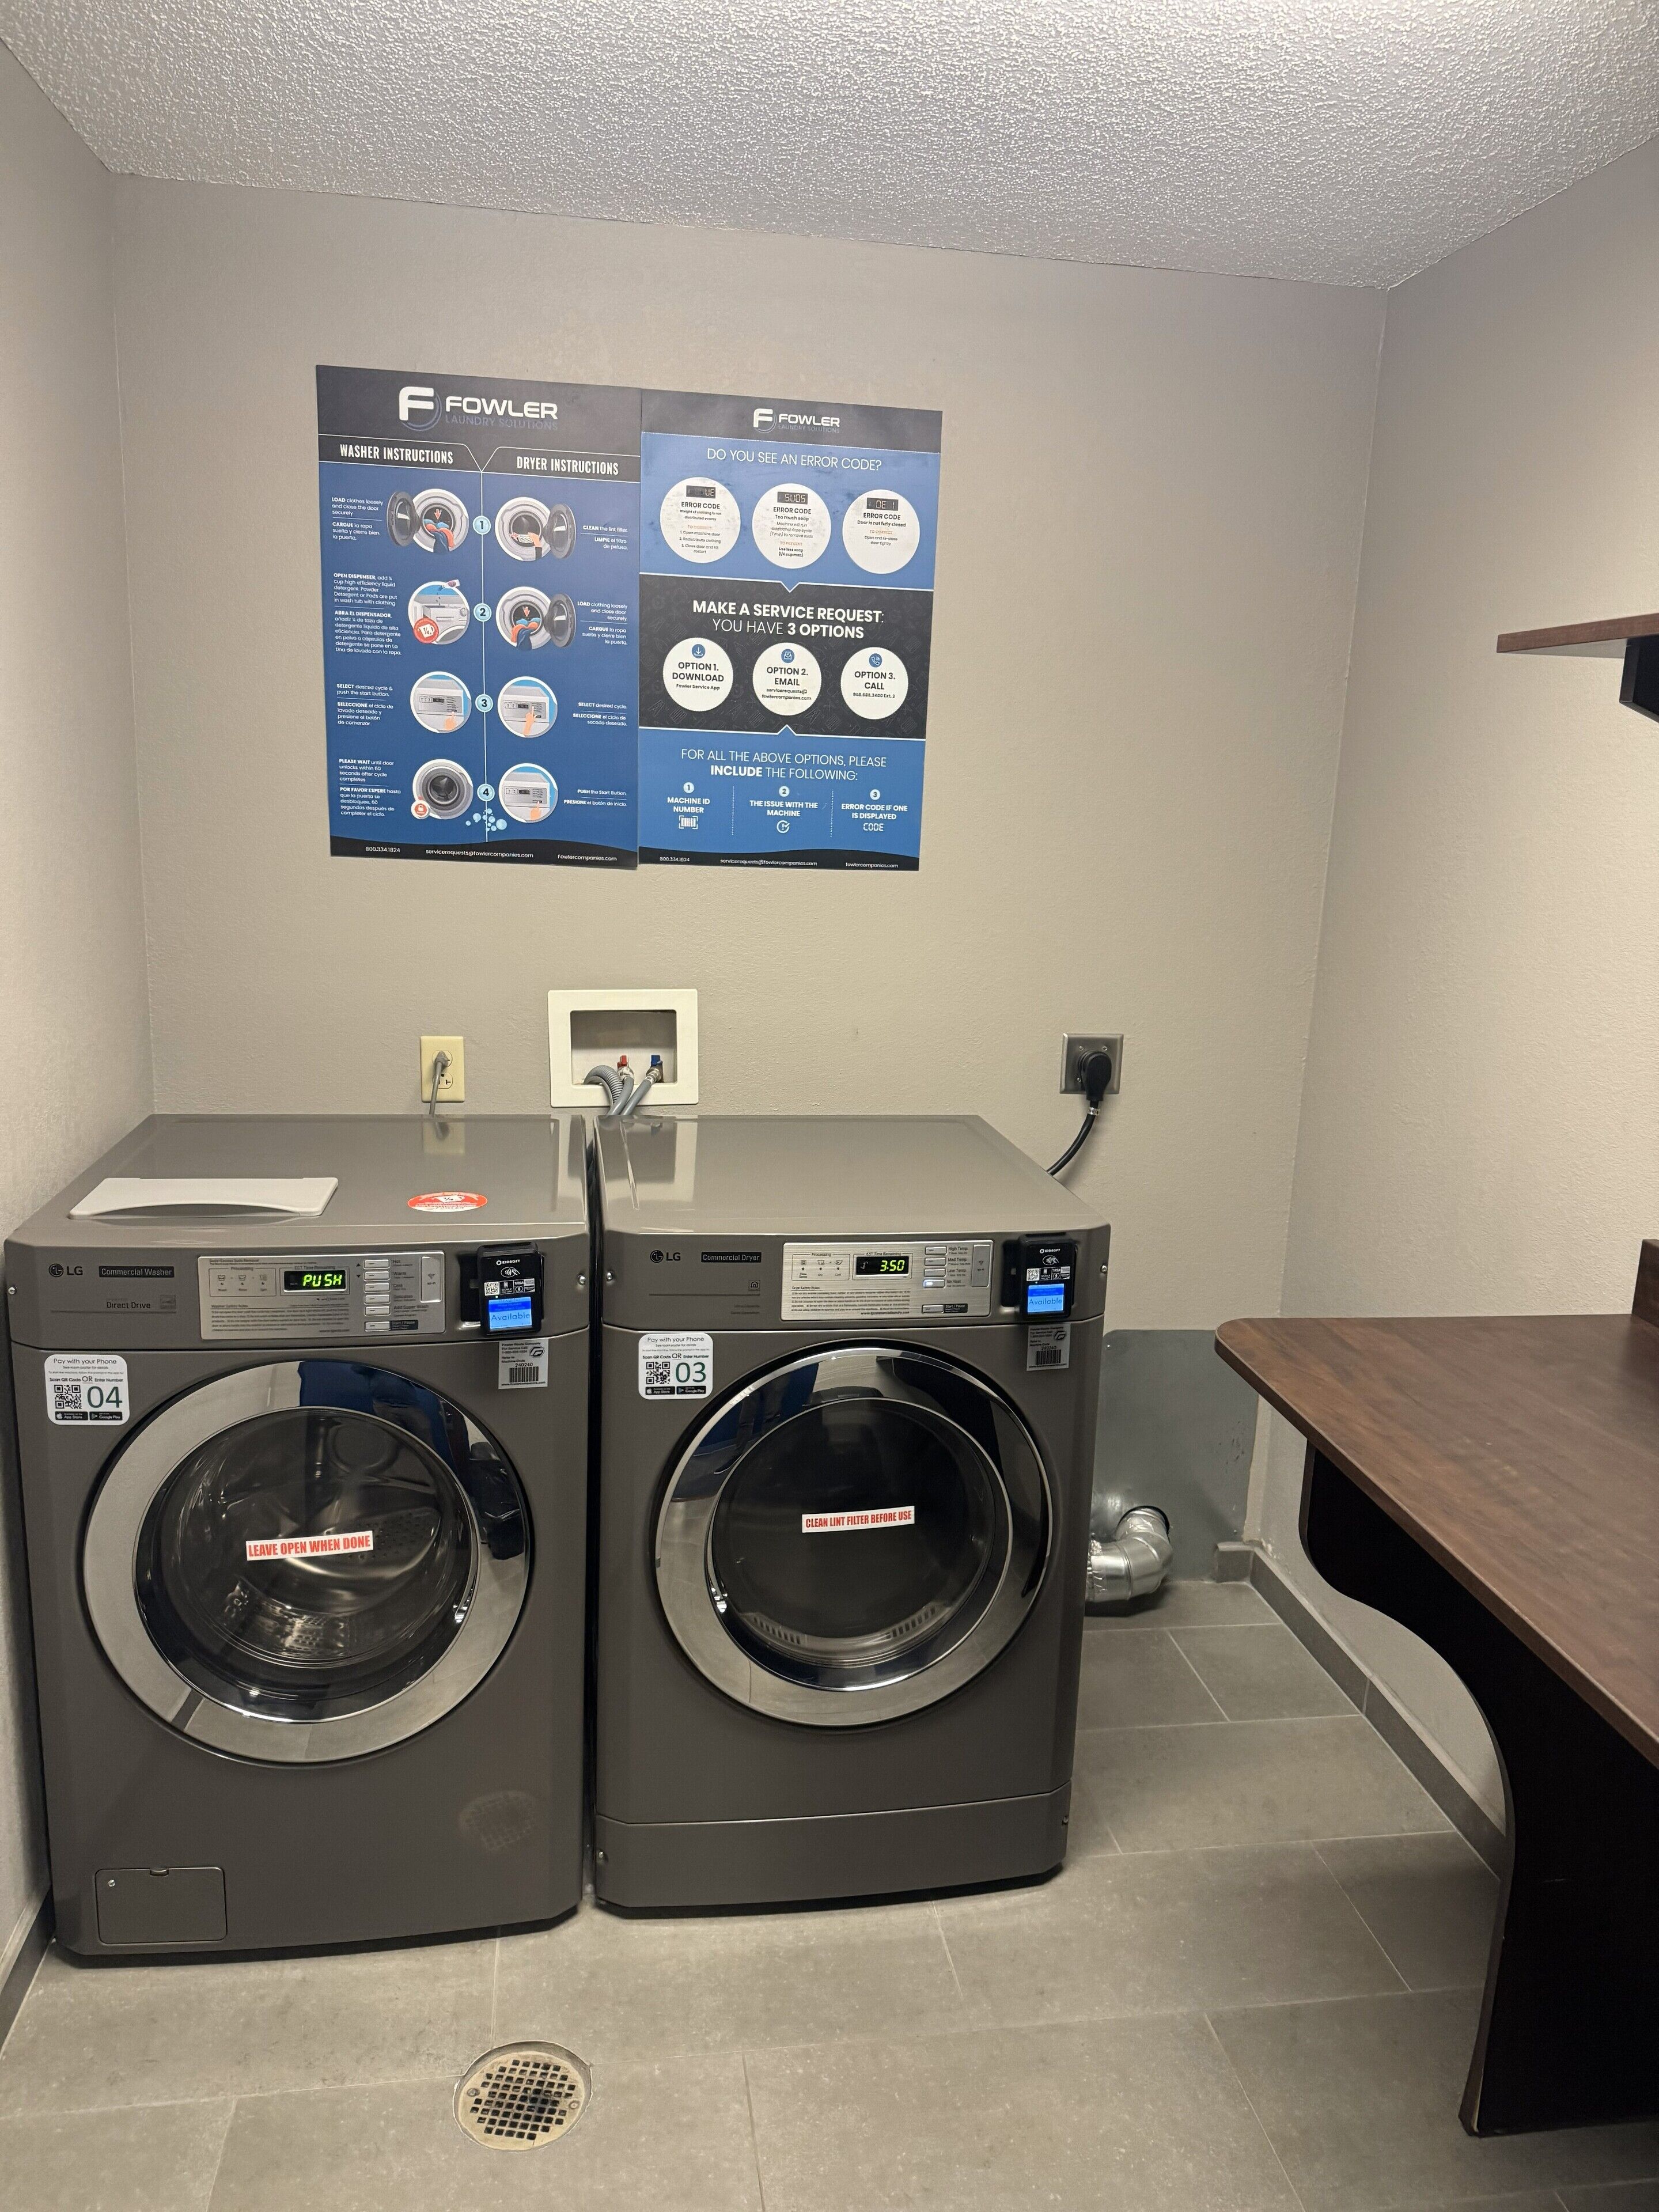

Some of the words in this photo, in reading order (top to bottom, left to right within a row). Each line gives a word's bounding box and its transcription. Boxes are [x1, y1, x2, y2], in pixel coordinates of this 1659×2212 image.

[446, 396, 558, 419] FOWLER
[446, 414, 495, 426] LAUNDRY
[499, 418, 558, 430] SOLUTIONS
[779, 414, 840, 427] FOWLER
[340, 444, 379, 459] WASHER
[384, 448, 453, 463] INSTRUCTIONS
[707, 448, 726, 460] DO
[730, 450, 754, 461] YOU
[758, 452, 778, 463] SEE
[781, 454, 797, 465] AN
[801, 455, 838, 468] ERROR
[842, 458, 881, 471] CODE?
[517, 457, 547, 471] DRYER
[551, 459, 619, 475] INSTRUCTIONS
[693, 600, 736, 615] MAKE
[739, 603, 750, 615] A
[754, 604, 814, 619] SERVICE
[817, 608, 884, 623] REQUEST:
[713, 619, 742, 632] YOU
[747, 620, 783, 634] HAVE
[787, 623, 796, 635] 3
[800, 624, 863, 638] OPTIONS
[678, 662, 711, 671] OPTION
[767, 666, 799, 675] OPTION
[672, 673, 724, 682] DOWNLOAD
[855, 671, 886, 679] OPTION
[681, 749, 704, 760] FOR
[707, 750, 726, 760] ALL
[729, 751, 749, 762] THE
[753, 752, 791, 763] ABOVE
[795, 754, 846, 767] OPTIONS,
[849, 756, 887, 767] PLEASE
[711, 766, 763, 777] INCLUDE
[766, 767, 786, 778] THE
[789, 768, 858, 780] FOLLOWING:
[863, 823, 884, 831] CODE
[426, 849, 533, 858] servicerequests@fowlercompanies.com
[666, 1252, 681, 1261] LG
[742, 1254, 760, 1263] Dryer
[67, 1266, 83, 1275] LG
[880, 1260, 905, 1271] 3.50
[303, 1274, 342, 1286] PUSH
[491, 1312, 530, 1321] Available
[676, 1362, 706, 1382] 03
[88, 1387, 123, 1408] 04
[806, 1518, 828, 1528] CLEAN
[830, 1517, 846, 1527] LINT
[847, 1515, 869, 1525] FILTER
[870, 1512, 897, 1524] BEFORE
[899, 1510, 911, 1521] USE
[249, 1543, 278, 1556] LEAVE
[281, 1541, 306, 1555] OPEN
[309, 1539, 340, 1552] WHEN
[343, 1535, 370, 1550] DONE
